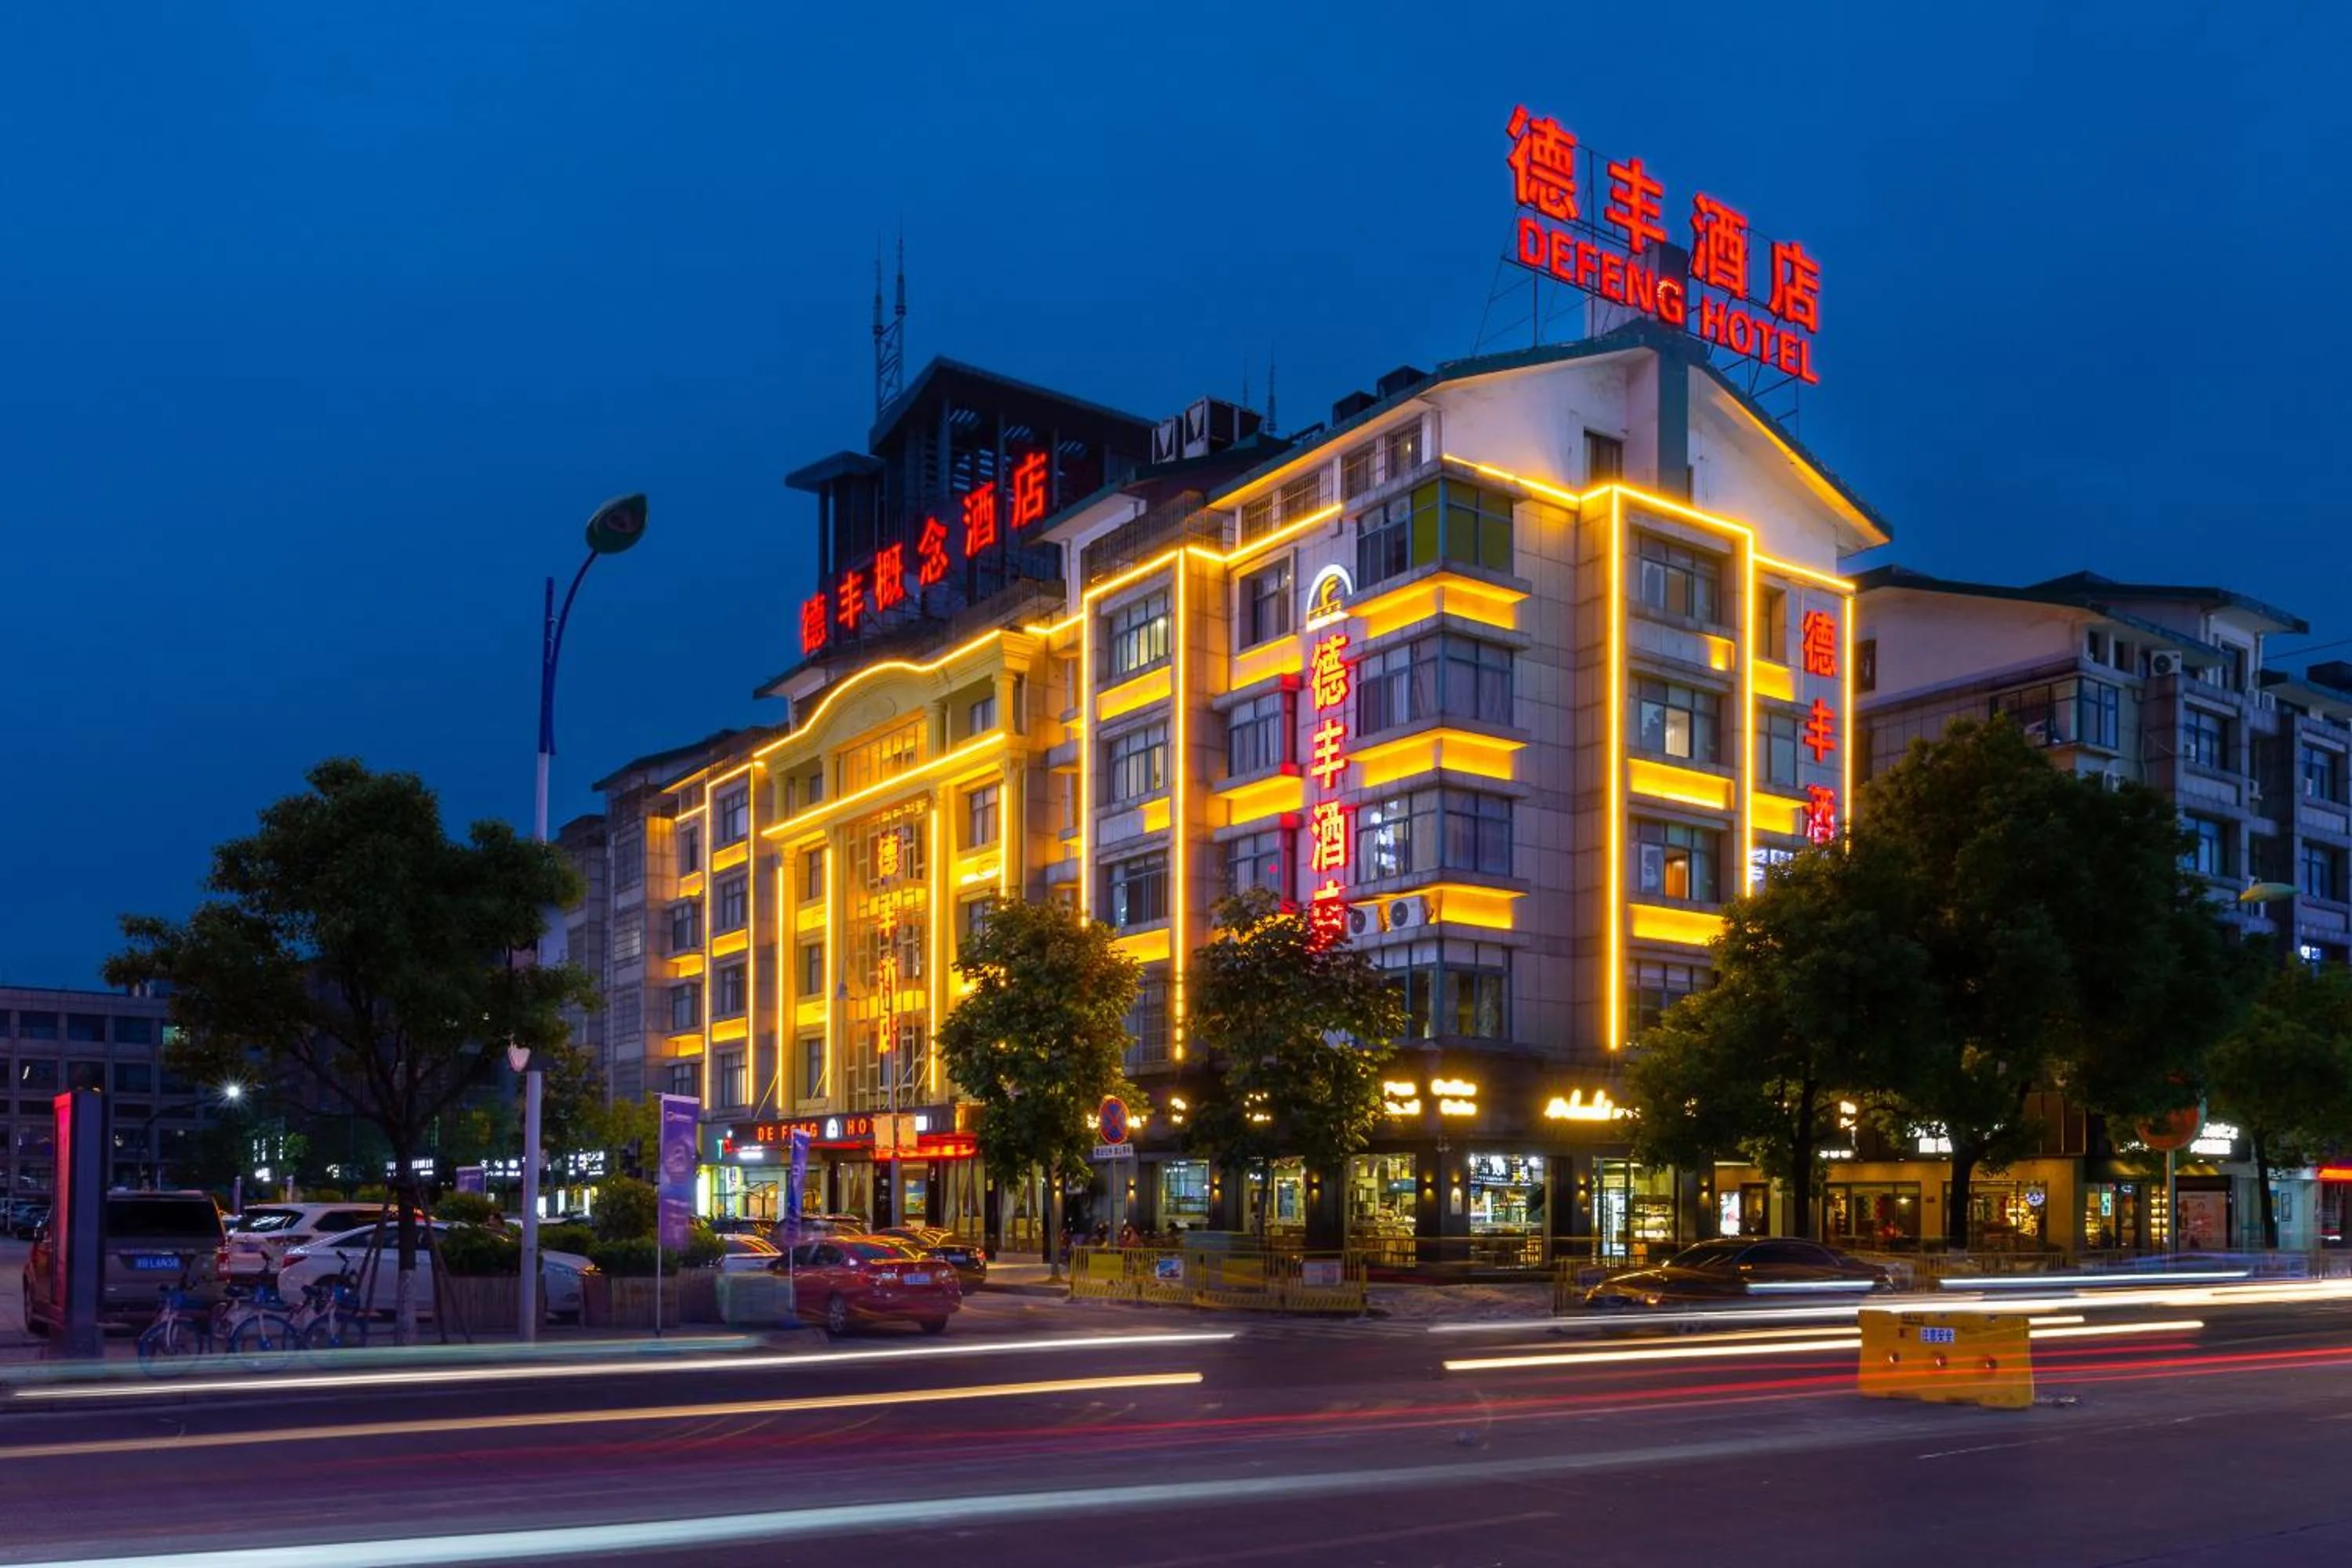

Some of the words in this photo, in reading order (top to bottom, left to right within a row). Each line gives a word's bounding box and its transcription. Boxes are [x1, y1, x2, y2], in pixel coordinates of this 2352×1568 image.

[1505, 104, 1819, 334] 德丰酒店
[1517, 217, 1684, 325] DEFENG
[1700, 296, 1819, 384] HOTEL
[801, 452, 1047, 654] 德丰概念酒店
[757, 1126, 775, 1142] DE
